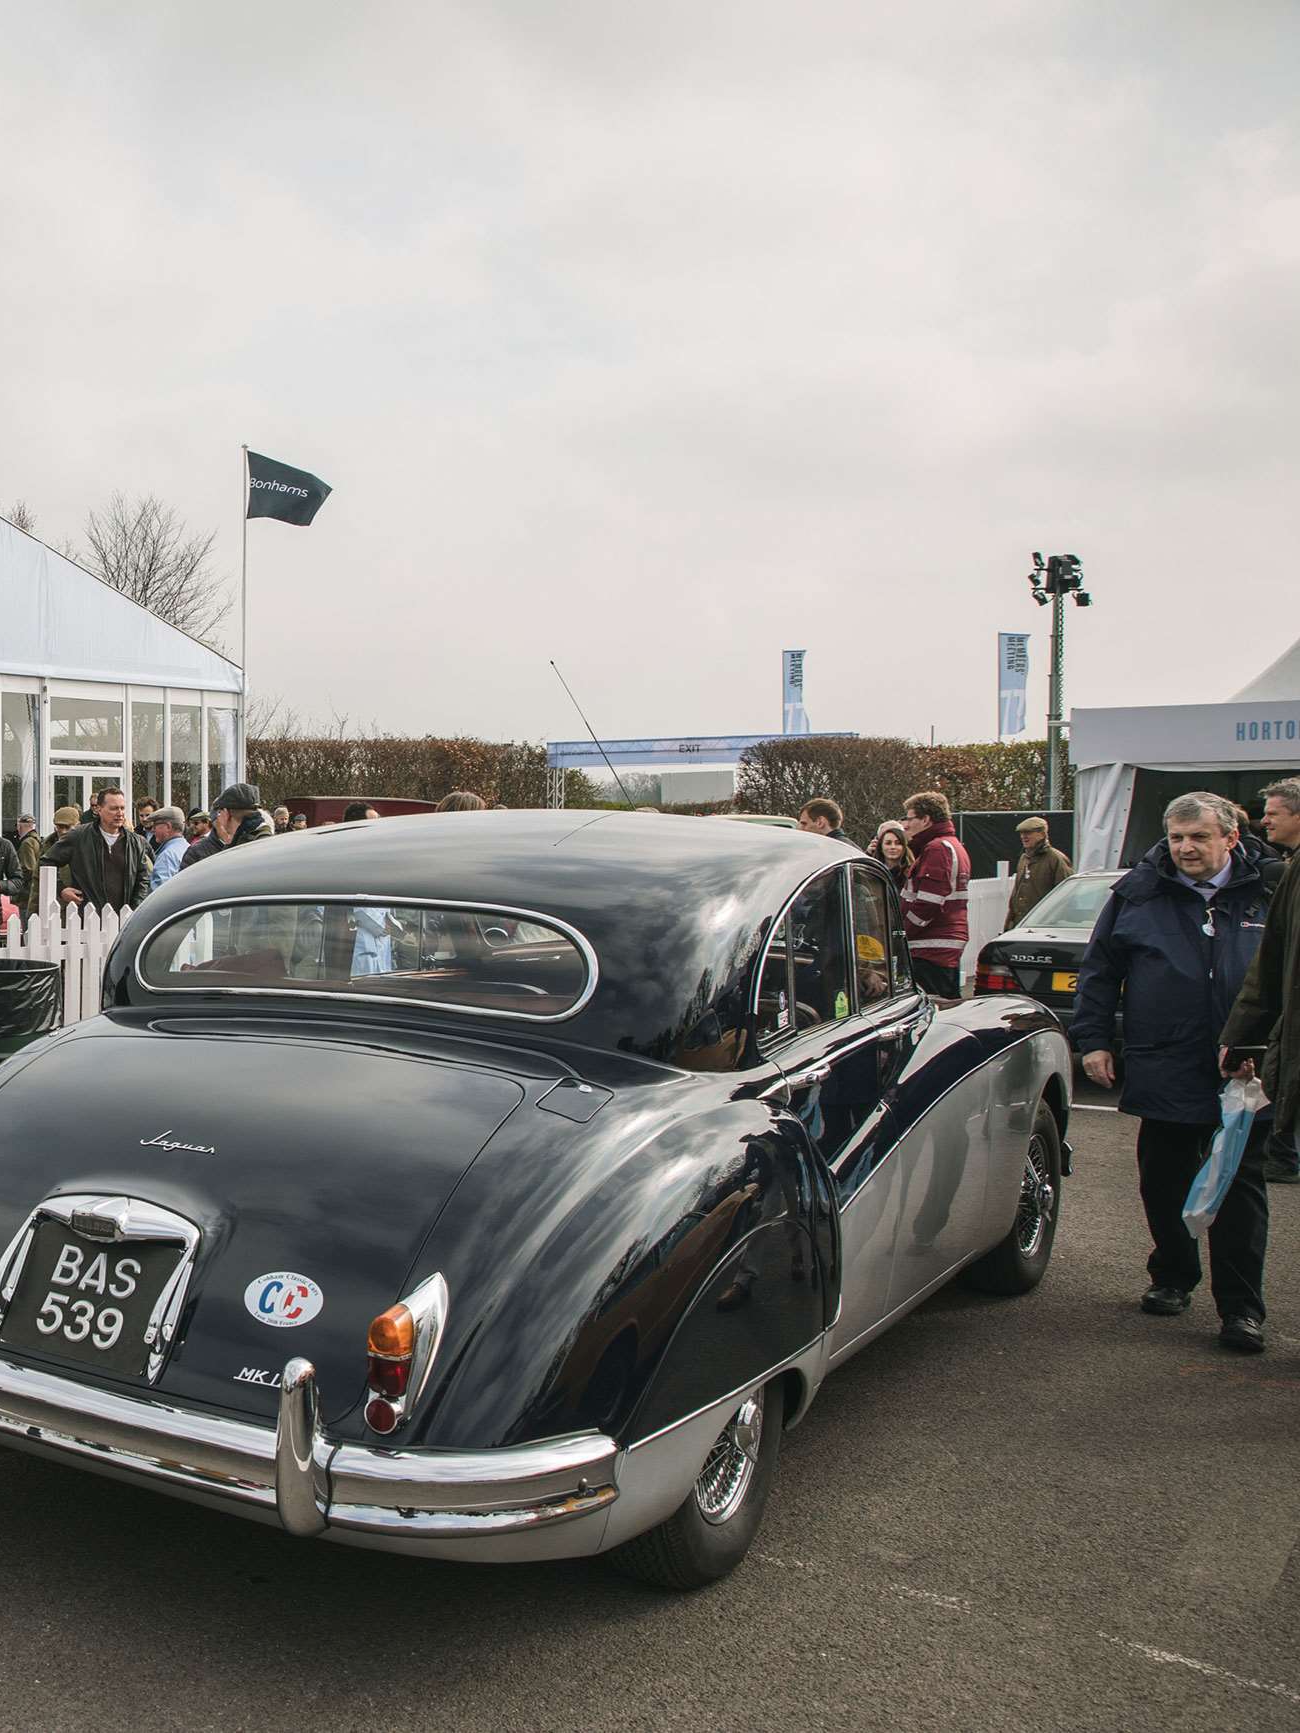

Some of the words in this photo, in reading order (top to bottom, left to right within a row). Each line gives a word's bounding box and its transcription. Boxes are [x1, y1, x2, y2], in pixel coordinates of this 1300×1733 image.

[248, 478, 309, 498] Bonhams
[1236, 720, 1300, 741] HORTO
[678, 744, 701, 753] EXIT
[140, 1130, 215, 1154] Jaguar
[51, 1244, 141, 1299] BAS
[36, 1292, 124, 1350] 539
